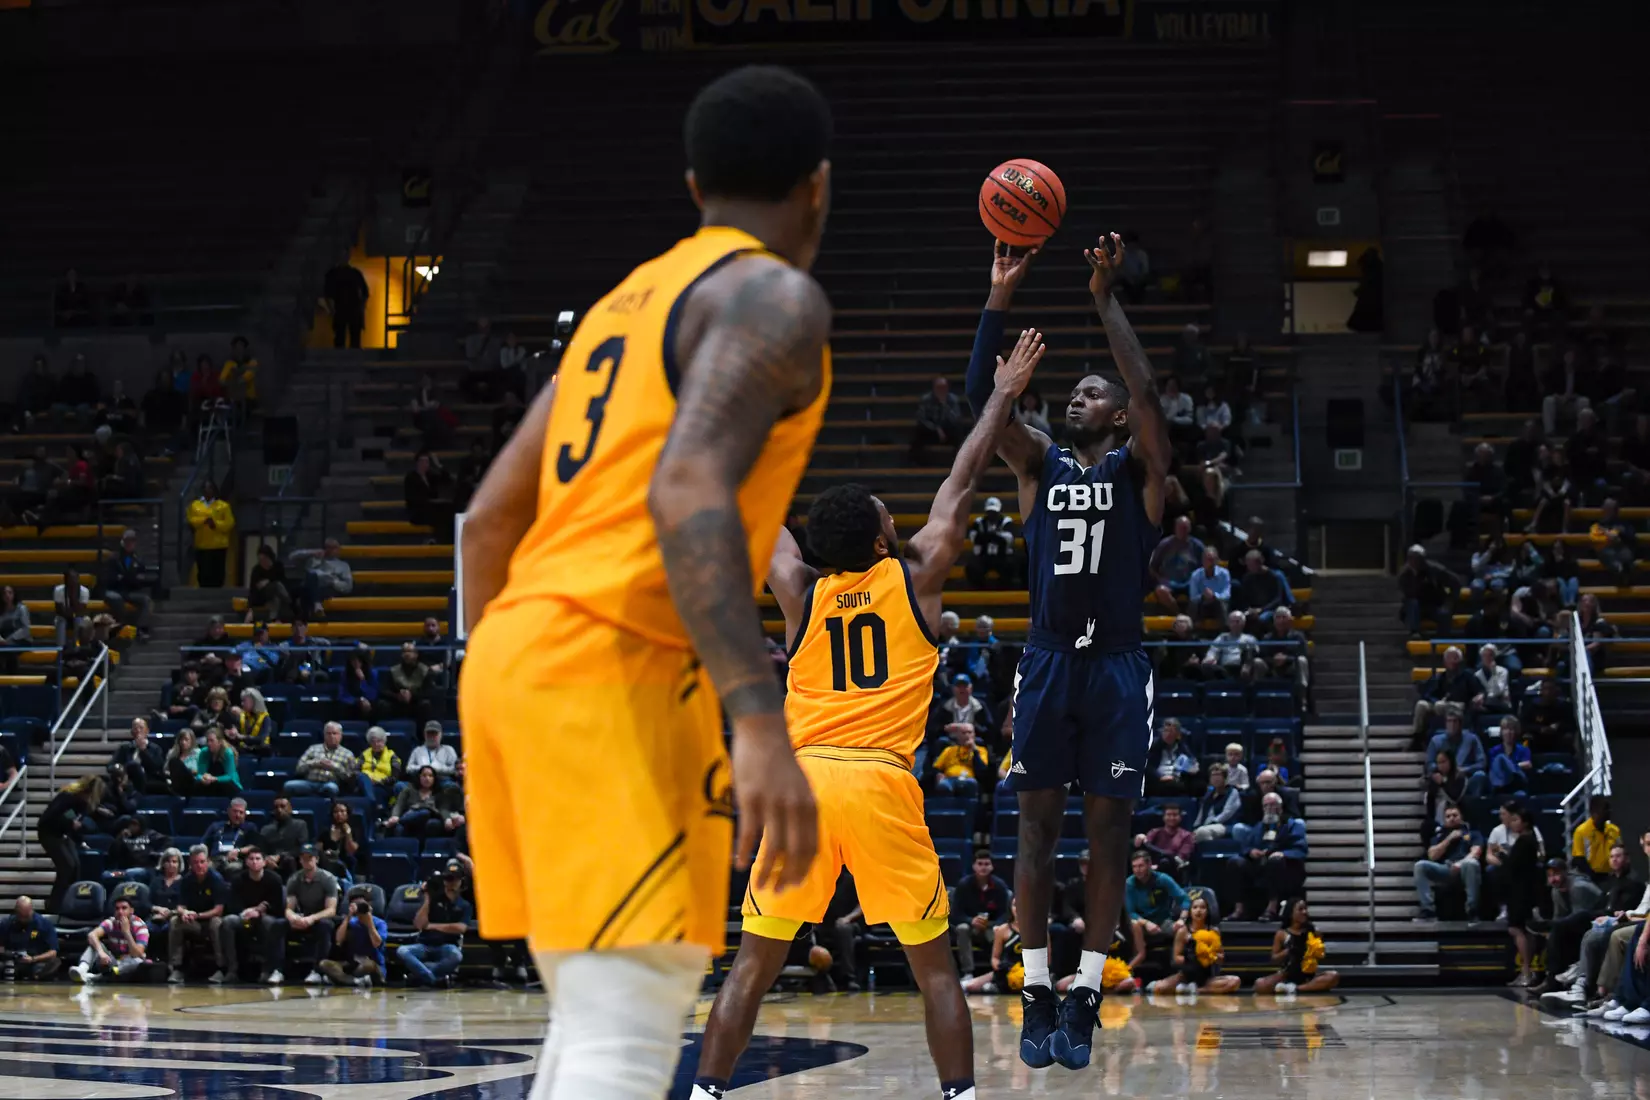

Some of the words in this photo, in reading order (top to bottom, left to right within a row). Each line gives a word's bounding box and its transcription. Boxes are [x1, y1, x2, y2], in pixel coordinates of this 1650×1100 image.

[533, 0, 623, 54] Cal
[1154, 11, 1275, 41] VOLLEYBALL
[991, 192, 1028, 225] NCAA
[1001, 167, 1049, 210] Wilson
[556, 335, 625, 484] 3
[1046, 482, 1114, 511] CBU
[1053, 518, 1105, 576] 31
[836, 591, 872, 609] SOUTH
[825, 612, 889, 692] 10
